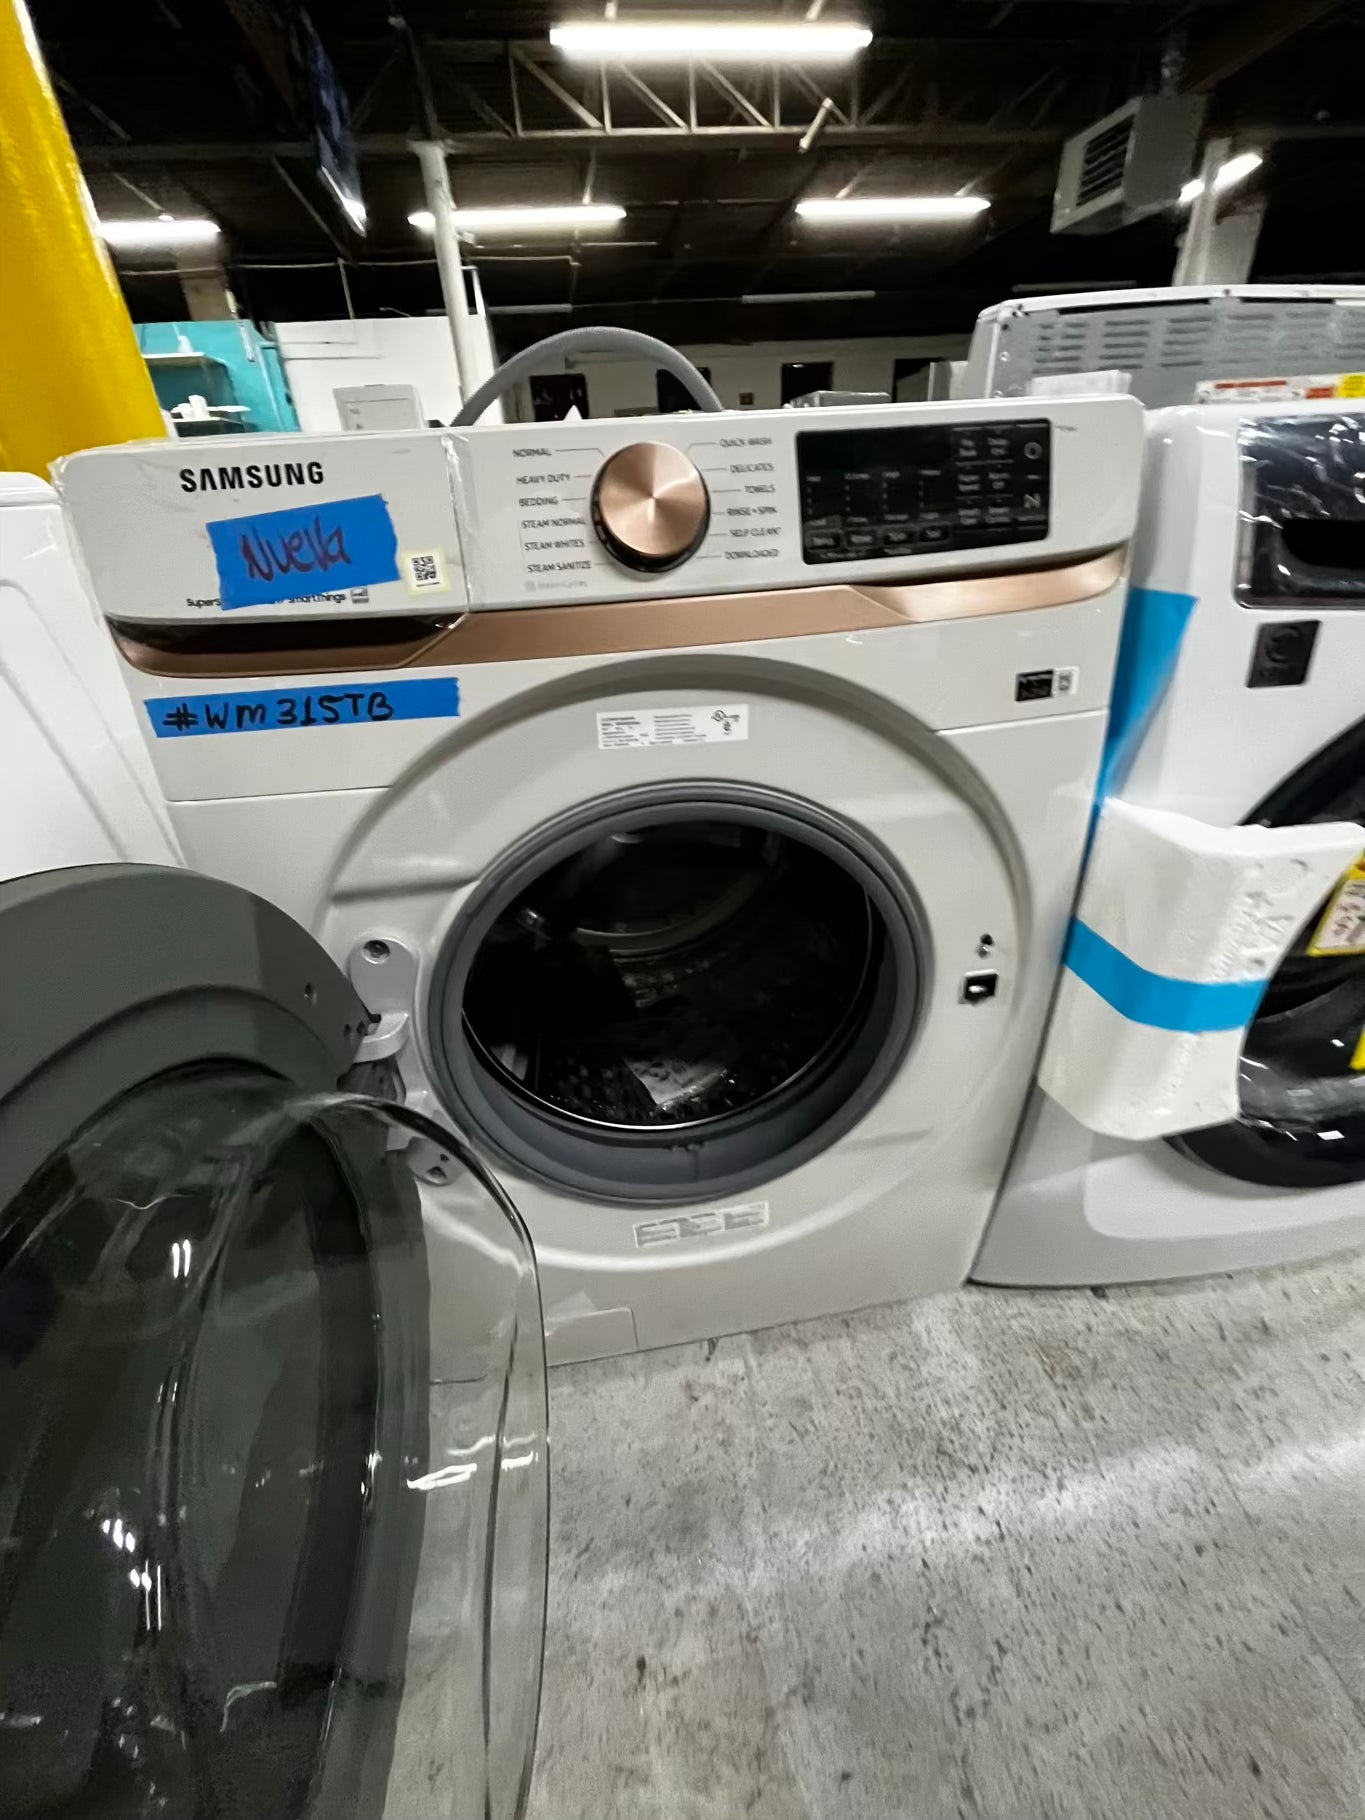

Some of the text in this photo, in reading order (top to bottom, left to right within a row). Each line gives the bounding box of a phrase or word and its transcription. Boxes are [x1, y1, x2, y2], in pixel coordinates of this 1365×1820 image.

[719, 438, 746, 448] QUICK
[512, 448, 552, 457] NORMAL
[729, 463, 775, 473] DELICATES
[179, 461, 324, 493] SAMSUNG
[516, 473, 571, 485] HEAVY DUTY
[744, 484, 776, 494] TOWELS
[518, 496, 559, 507] BEDDING
[521, 517, 588, 529] STEAM NORMAL
[729, 528, 750, 538] SELF
[524, 538, 585, 551] STEAM WHITES
[724, 549, 780, 560] DOWNLOADED
[526, 560, 593, 573] STEAM SANITIZE
